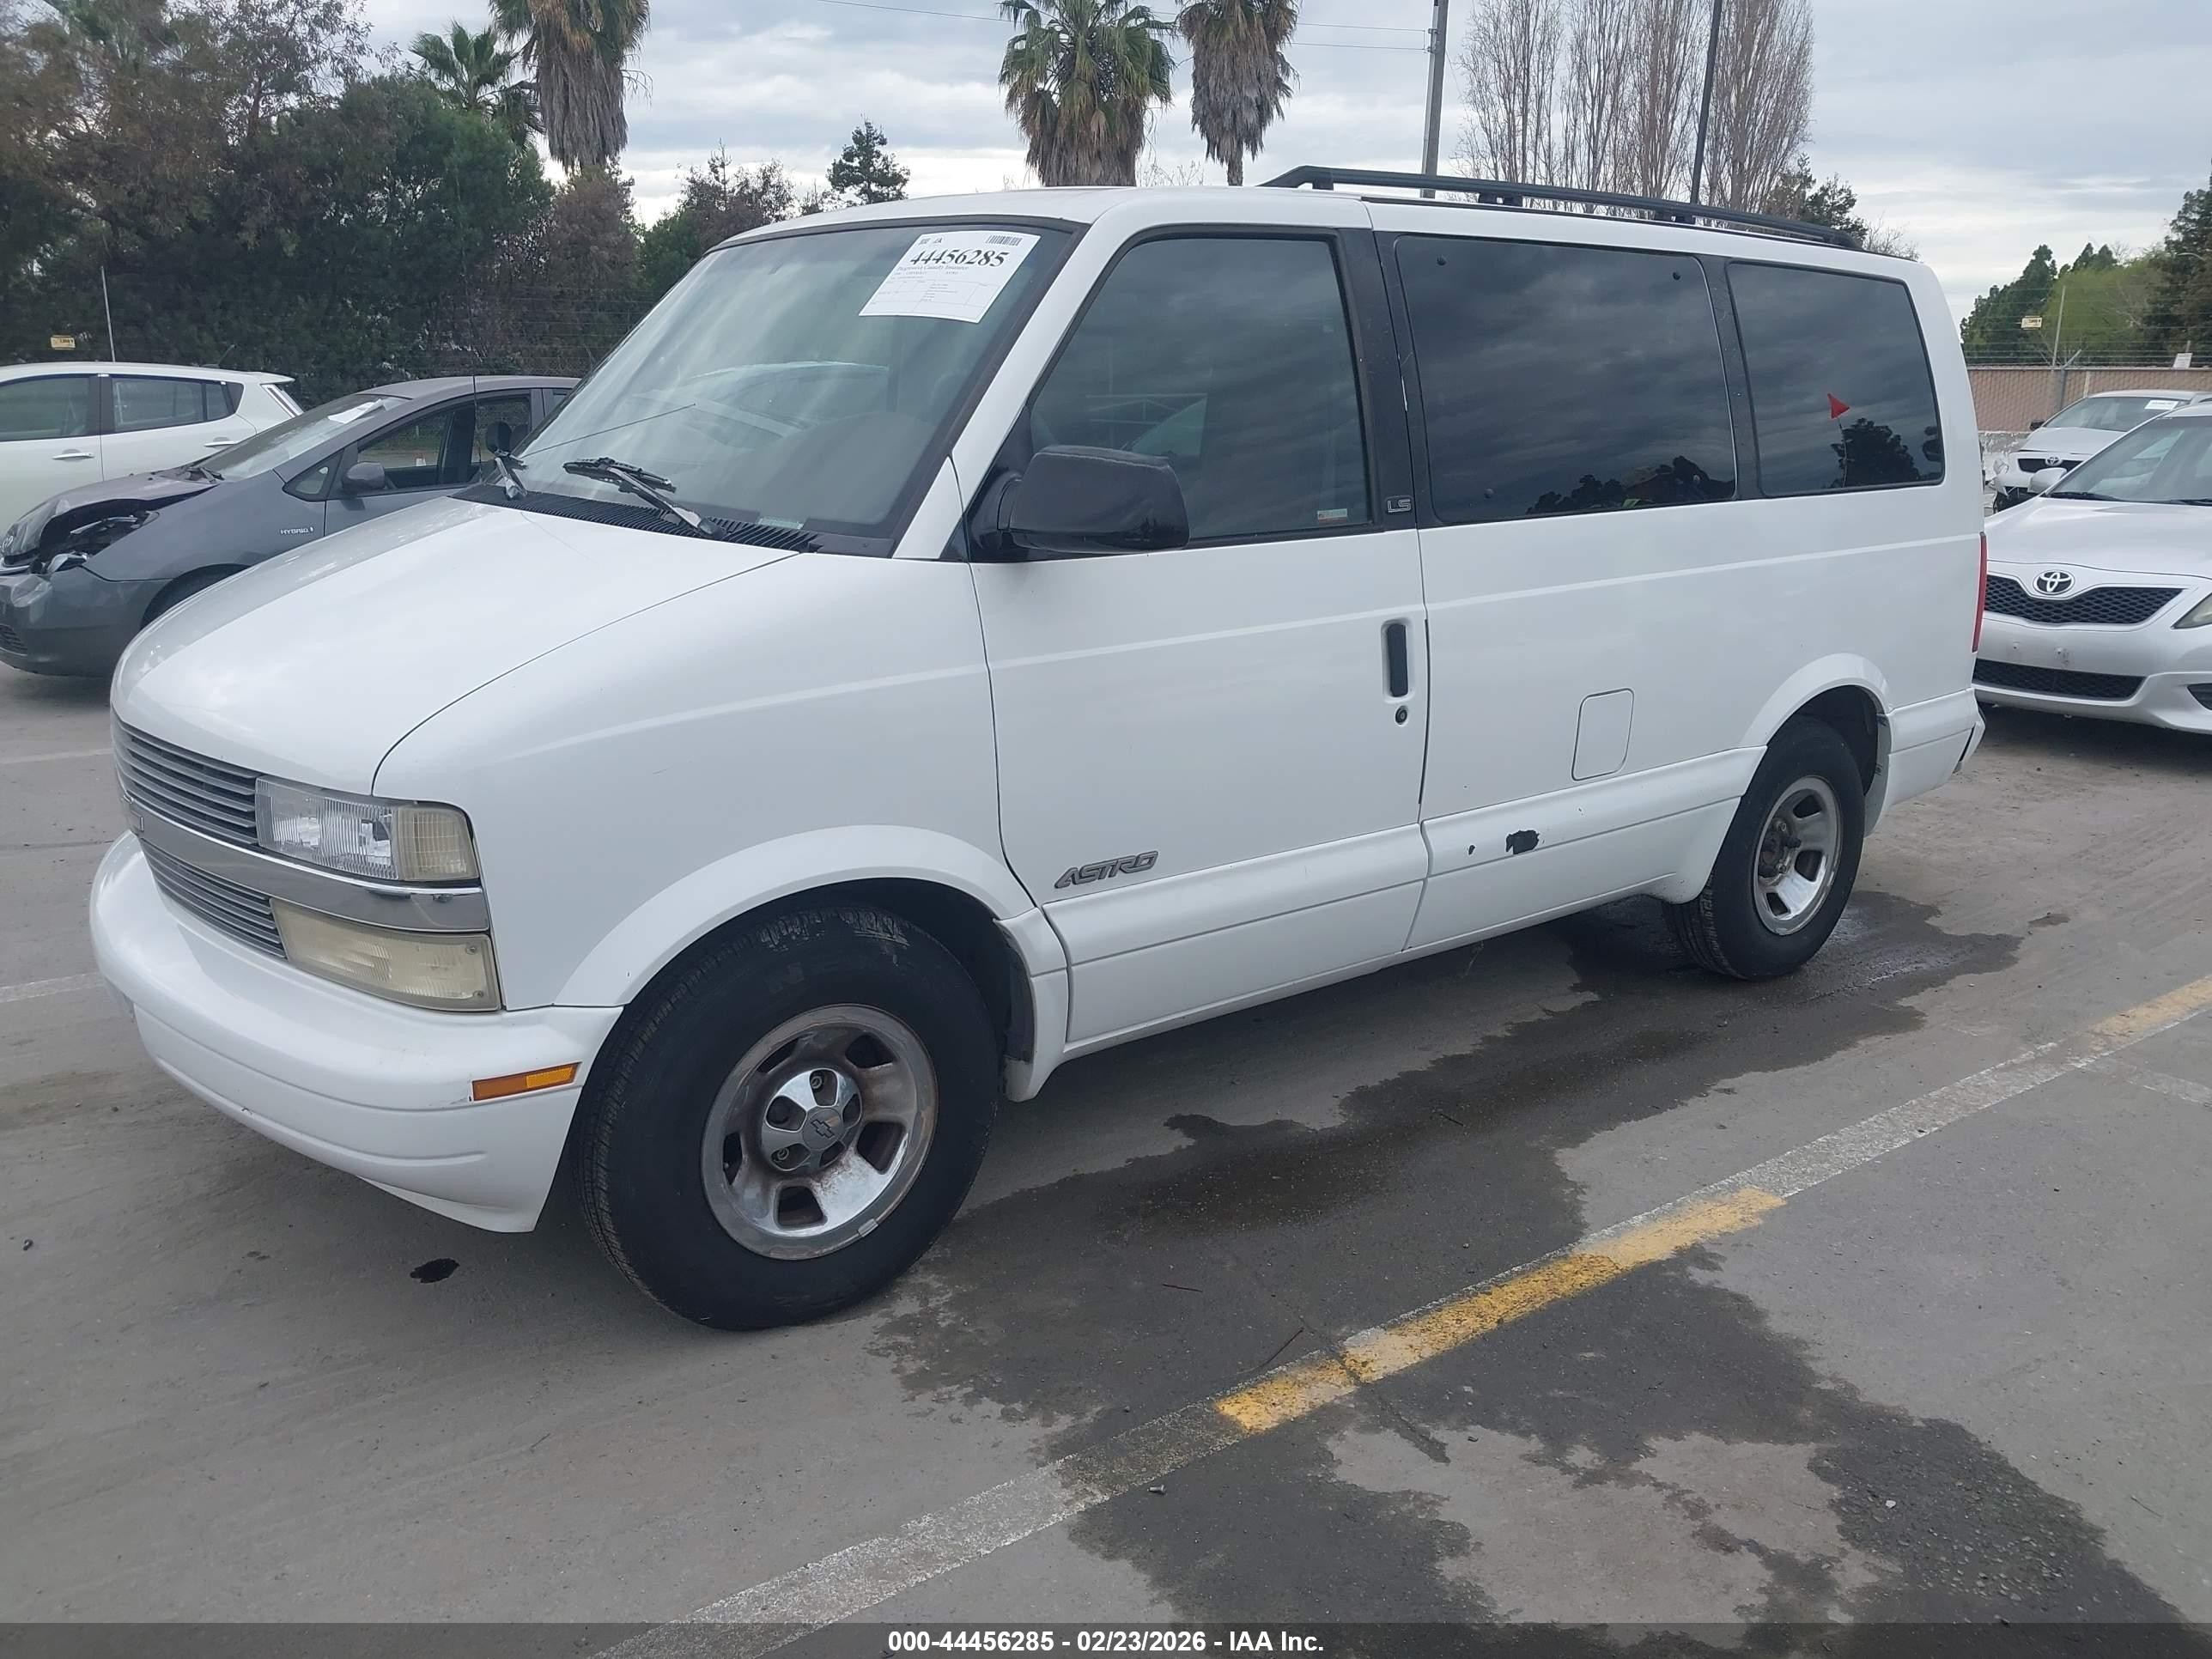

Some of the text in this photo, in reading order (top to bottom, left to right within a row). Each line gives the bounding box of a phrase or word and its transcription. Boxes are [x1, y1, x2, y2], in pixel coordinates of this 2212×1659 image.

[910, 249, 1010, 267] 44456285
[1388, 500, 1411, 513] LS
[1054, 850, 1159, 889] ASTRO
